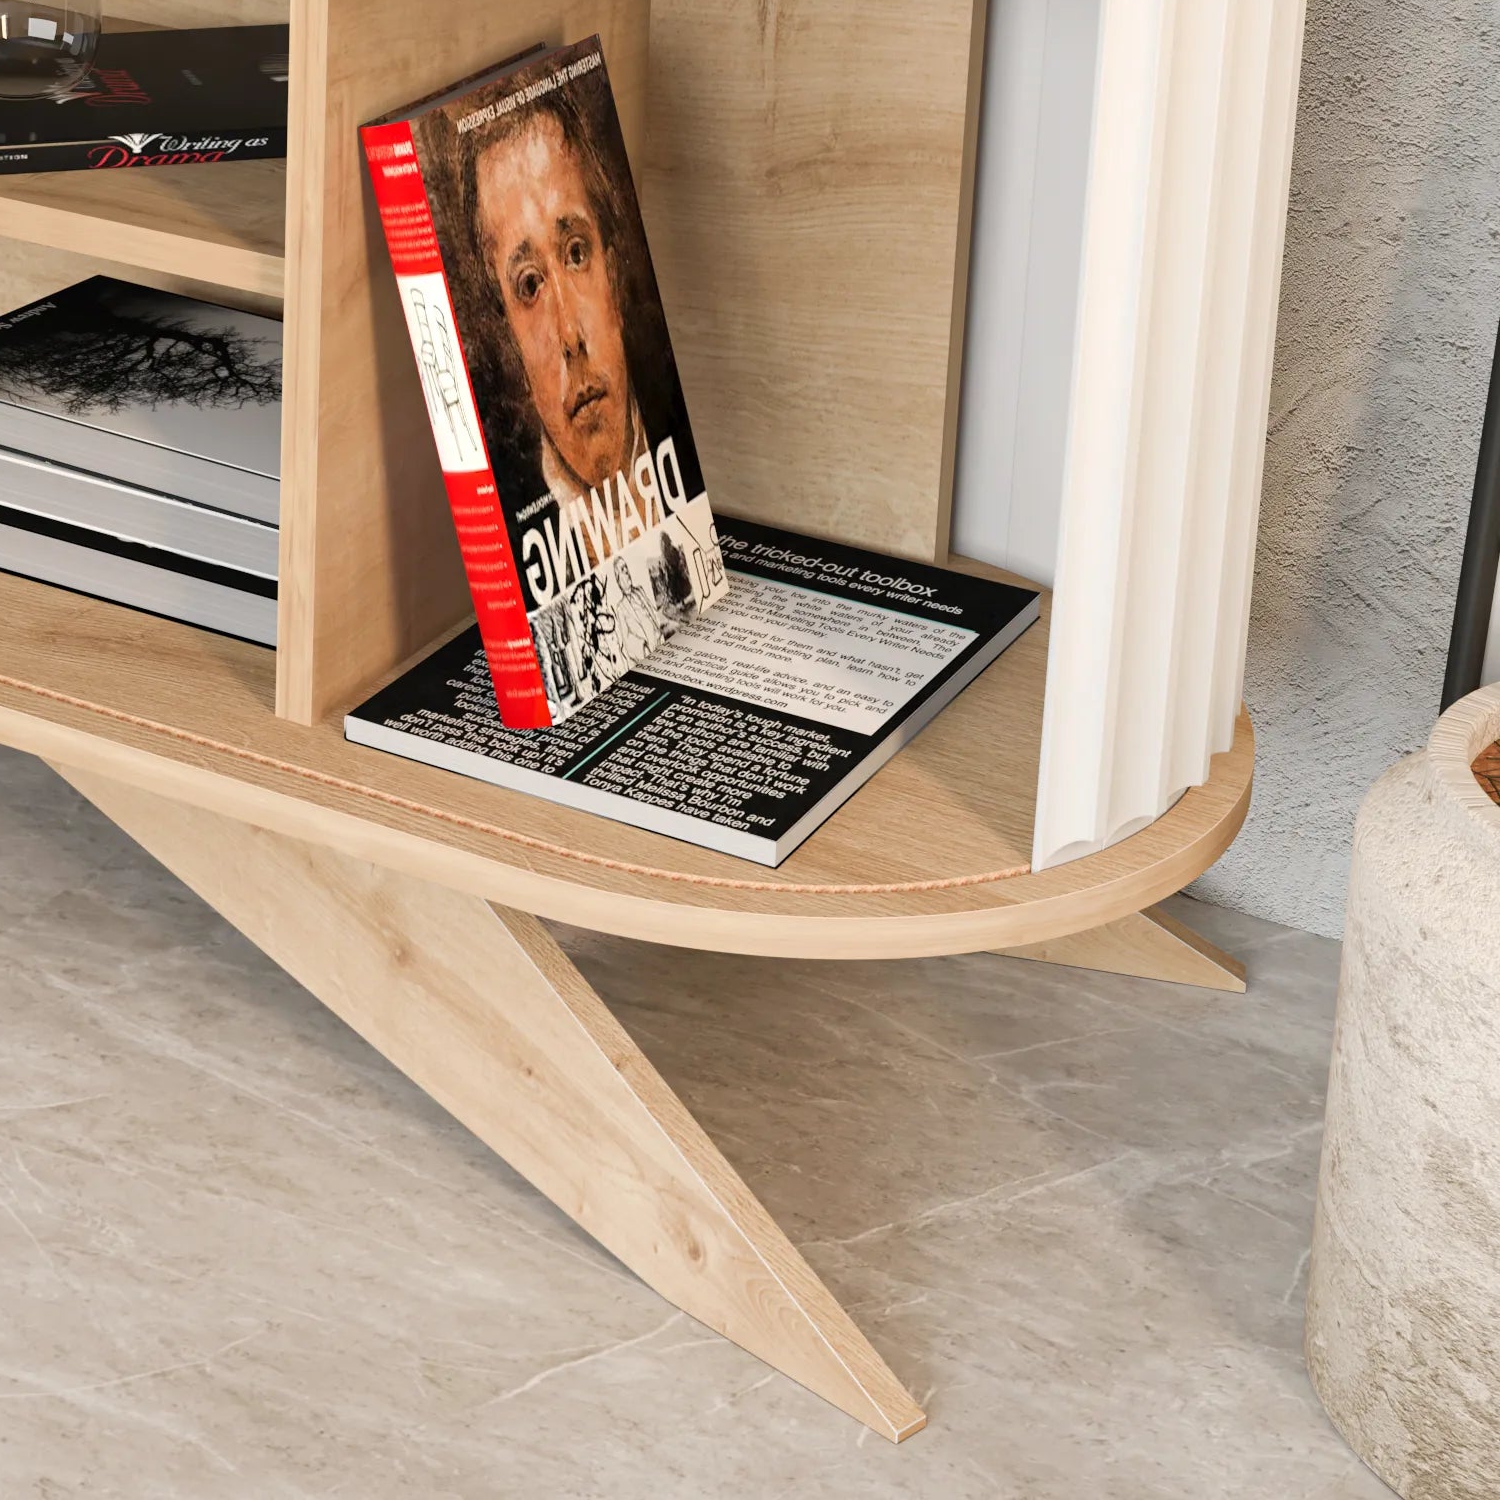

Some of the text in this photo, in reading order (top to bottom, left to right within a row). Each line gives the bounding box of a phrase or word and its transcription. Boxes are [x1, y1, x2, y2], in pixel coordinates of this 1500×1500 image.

[86, 145, 225, 169] Drama
[157, 134, 269, 155] Writing as
[717, 534, 938, 597] the tricked-out toolbox
[728, 552, 963, 615] and marketing tools every writer needs
[642, 723, 792, 770] all the tools available to
[651, 715, 830, 771] few authors are familiar with
[660, 707, 831, 761] to an author's success, but
[665, 702, 852, 758] promotion is a key ingredient
[680, 694, 830, 744] "In today's tough market,
[595, 758, 742, 806] impact. That's why I'm
[607, 751, 753, 799] that might create more
[615, 745, 786, 799] and overlook opportunities
[625, 738, 807, 794] on the things that don't work
[634, 729, 668, 746] them.
[673, 740, 708, 757] They
[707, 751, 752, 768] spend
[761, 765, 810, 785] fortune
[582, 773, 750, 829] Tonya Kappes have taken
[589, 766, 776, 826] thrilled Melissa Bourbon and
